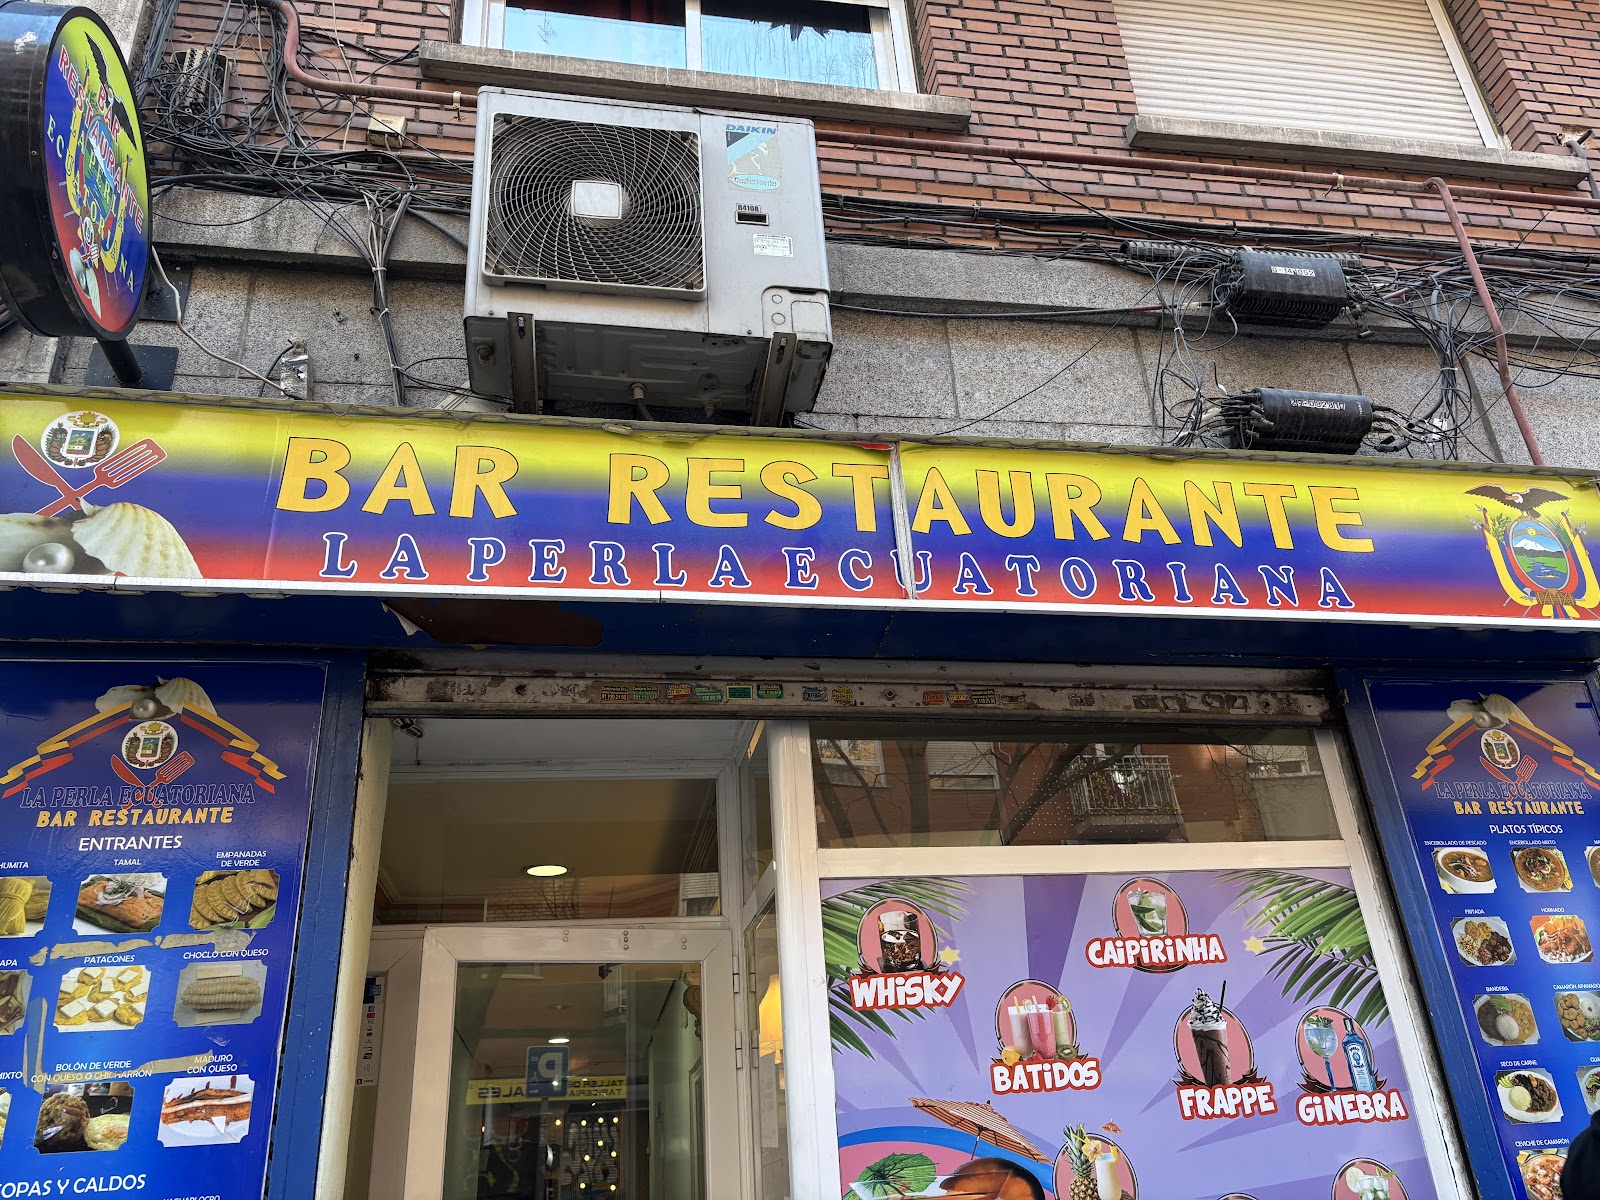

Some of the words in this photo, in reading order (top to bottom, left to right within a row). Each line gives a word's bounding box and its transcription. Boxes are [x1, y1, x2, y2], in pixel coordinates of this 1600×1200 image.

[726, 124, 777, 135] DAIKIN
[58, 44, 145, 235] RESTAURANTE
[275, 437, 519, 519] BAR
[607, 453, 1375, 554] RESTAURANTE
[319, 531, 430, 580] LA
[466, 537, 752, 588] PERLA
[781, 546, 1356, 609] ECUATORIANA
[20, 786, 48, 809] LA
[51, 785, 114, 807] PERLA
[118, 783, 256, 806] ECUATORIANA
[1433, 781, 1452, 799] LA
[1453, 781, 1499, 799] PERLA
[1499, 780, 1593, 800] ECUATORIANA
[1454, 801, 1483, 815] BAR
[1488, 801, 1585, 815] RESTAURANTE
[36, 810, 77, 828] BAR
[89, 807, 235, 827] RESTAURANTE
[1489, 824, 1527, 834] PLATOS
[1528, 822, 1564, 834] TÍPICOS
[78, 836, 183, 853] ENTRANTES
[216, 850, 267, 859] EMPANADAS
[113, 858, 142, 867] TAMAL
[221, 860, 232, 868] DE
[234, 858, 260, 867] VERDE
[83, 954, 135, 965] PATACONES
[183, 951, 219, 960] CHOCLO
[220, 950, 239, 959] CON
[240, 948, 269, 958] QUESO
[0, 958, 18, 968] APA
[55, 1060, 87, 1071] BOLÓN
[89, 1061, 101, 1071] DE
[103, 1060, 132, 1070] VERDE
[194, 1054, 233, 1065] MADURO
[31, 1073, 50, 1084] CON
[53, 1072, 83, 1083] QUESO
[93, 1068, 153, 1081] CHICHARRÓN
[186, 1065, 205, 1075] CON
[208, 1064, 238, 1075] QUESO
[1180, 1085, 1275, 1117] FRAPPE
[57, 1178, 71, 1195] Y
[73, 1174, 147, 1193] CALDOS
